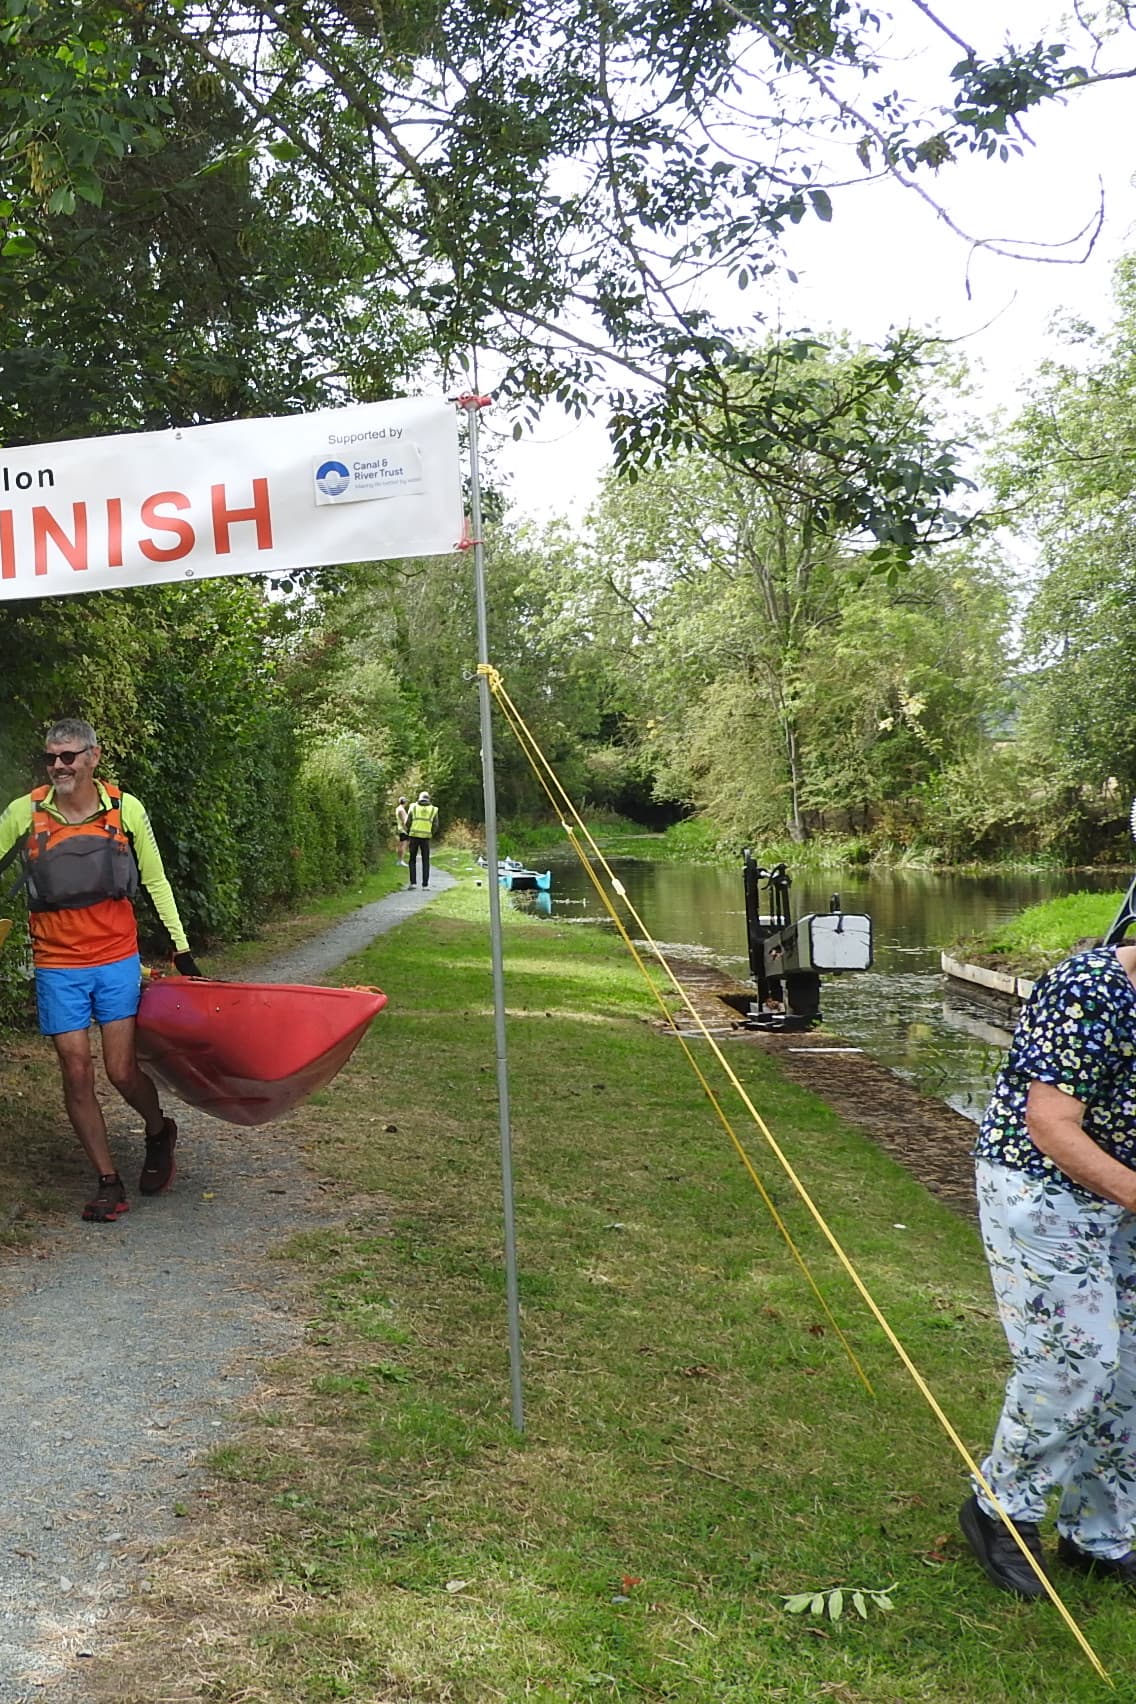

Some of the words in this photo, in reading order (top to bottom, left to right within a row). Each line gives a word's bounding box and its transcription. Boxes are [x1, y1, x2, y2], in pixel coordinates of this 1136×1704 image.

[328, 428, 386, 445] Supported
[389, 427, 403, 440] by
[353, 459, 380, 471] Canal
[354, 471, 378, 481] River
[379, 468, 404, 478] Trust
